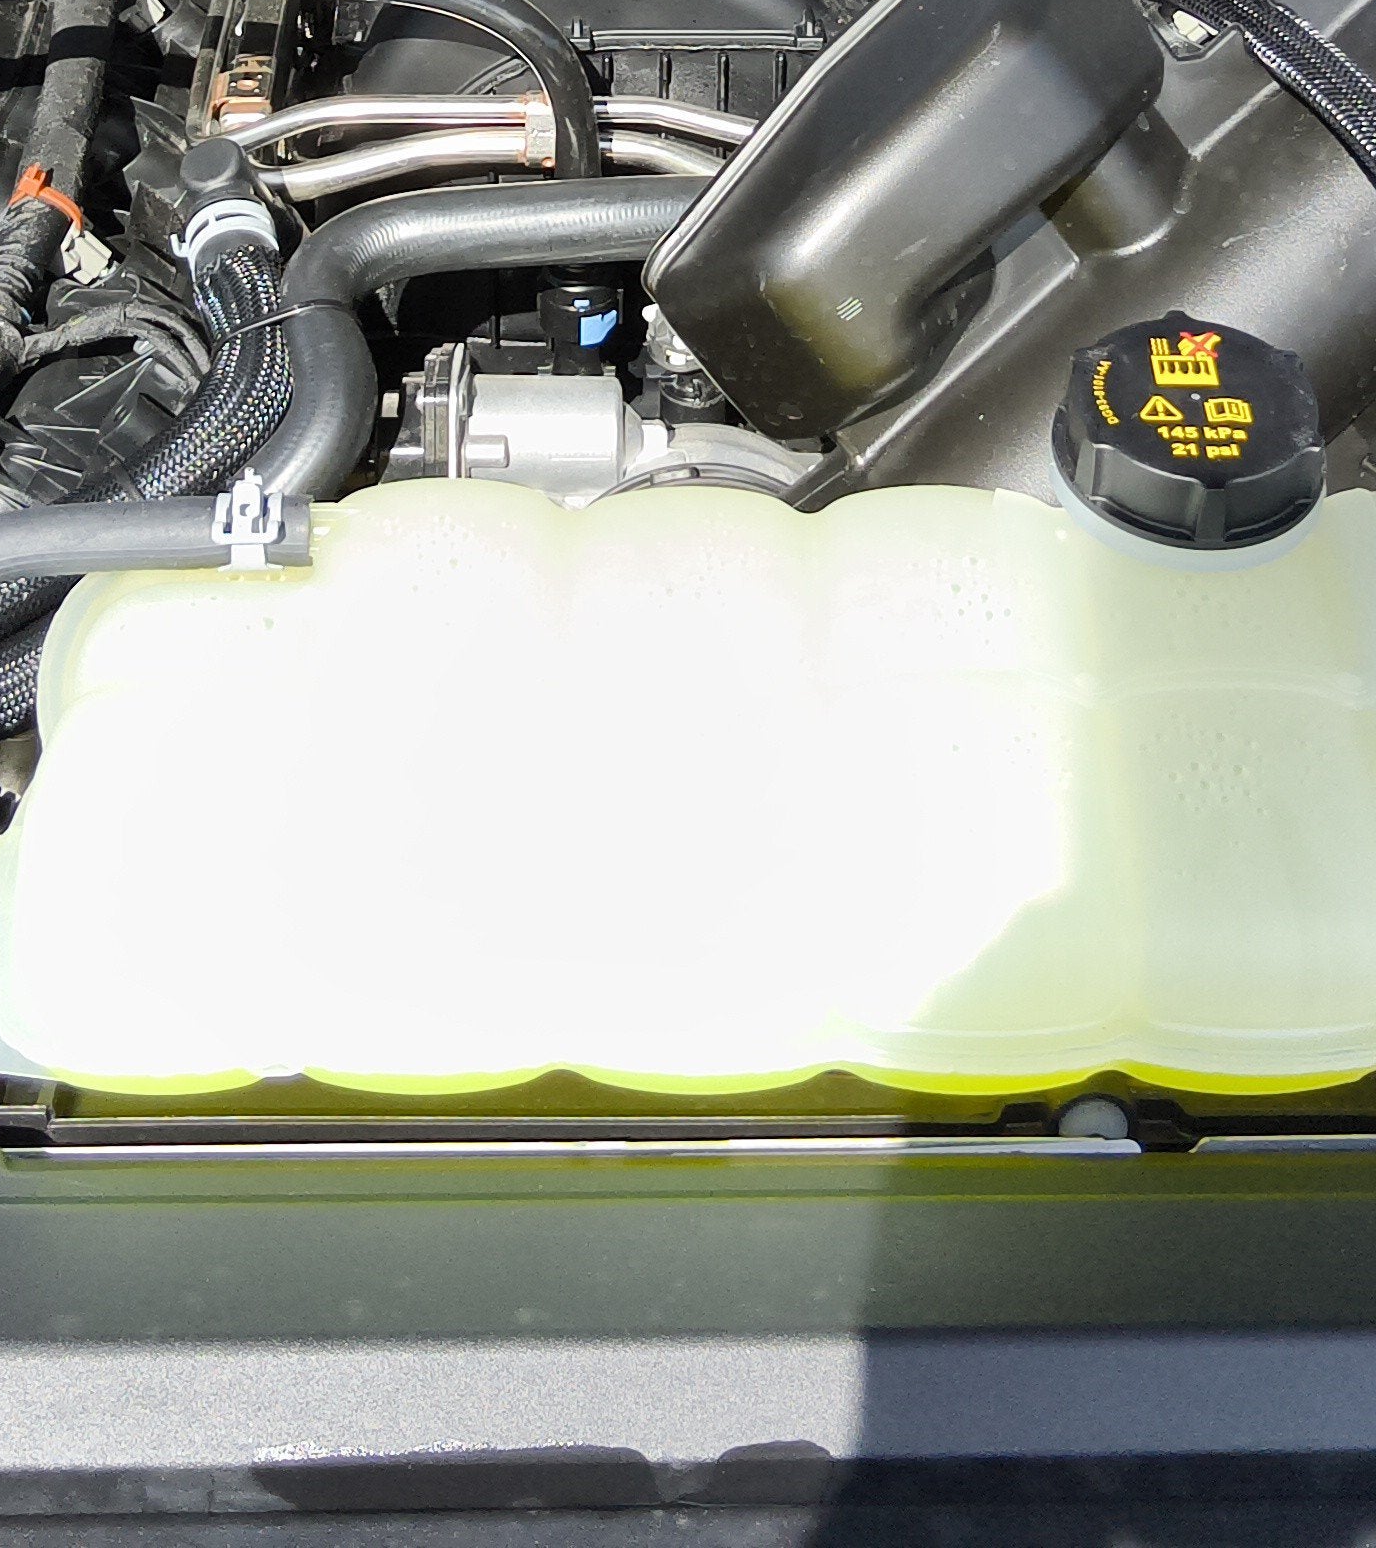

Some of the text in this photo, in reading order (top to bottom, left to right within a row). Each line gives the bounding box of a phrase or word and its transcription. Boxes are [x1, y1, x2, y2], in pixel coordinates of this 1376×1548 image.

[1157, 425, 1248, 441] 145 kPa
[1171, 442, 1241, 460] 21 psi
